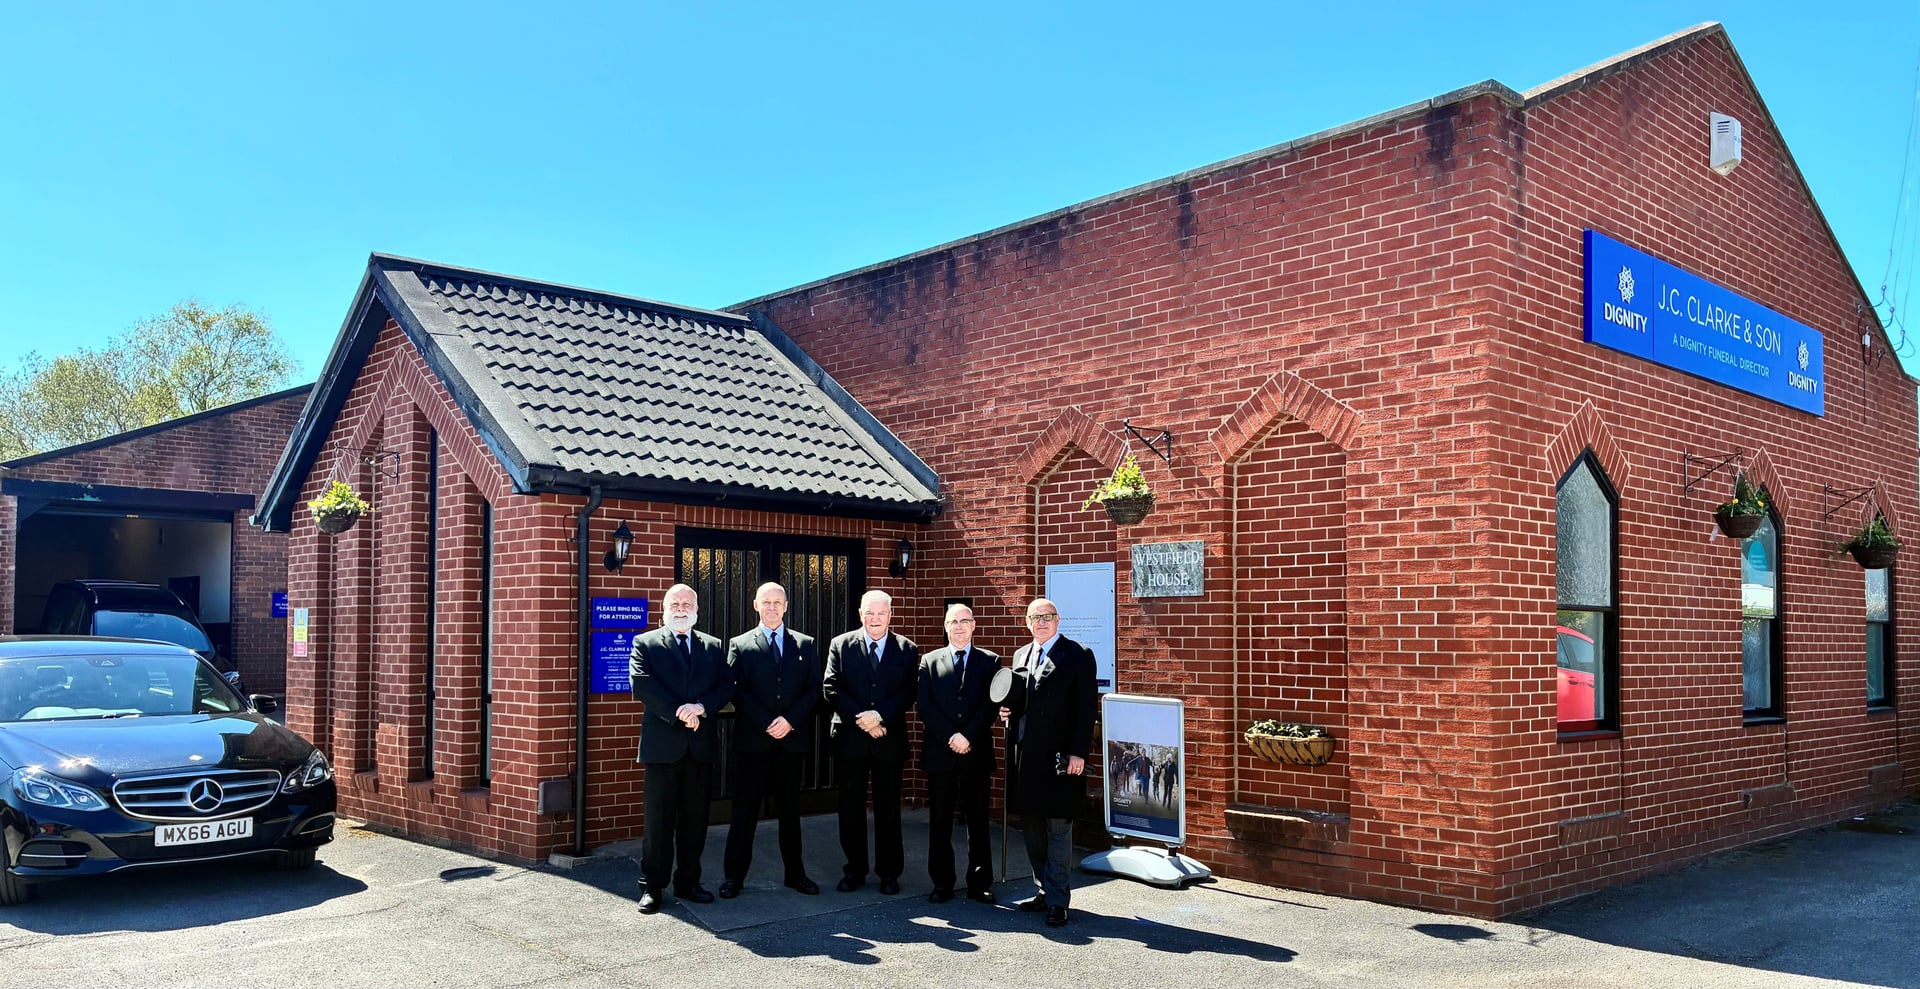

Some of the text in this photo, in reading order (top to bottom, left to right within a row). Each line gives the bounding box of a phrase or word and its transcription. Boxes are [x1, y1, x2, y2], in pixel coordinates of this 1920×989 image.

[1604, 302, 1647, 333] DIGNITY
[1658, 284, 1781, 356] J.C. CLARKE & SON
[1672, 332, 1770, 378] A DIGNITY FUNERAL DIRECTOR
[1788, 371, 1818, 394] DIGNITY
[1135, 551, 1200, 566] WESTFIELD
[1148, 572, 1189, 587] HOUSE
[163, 820, 247, 842] MX66 AGU
